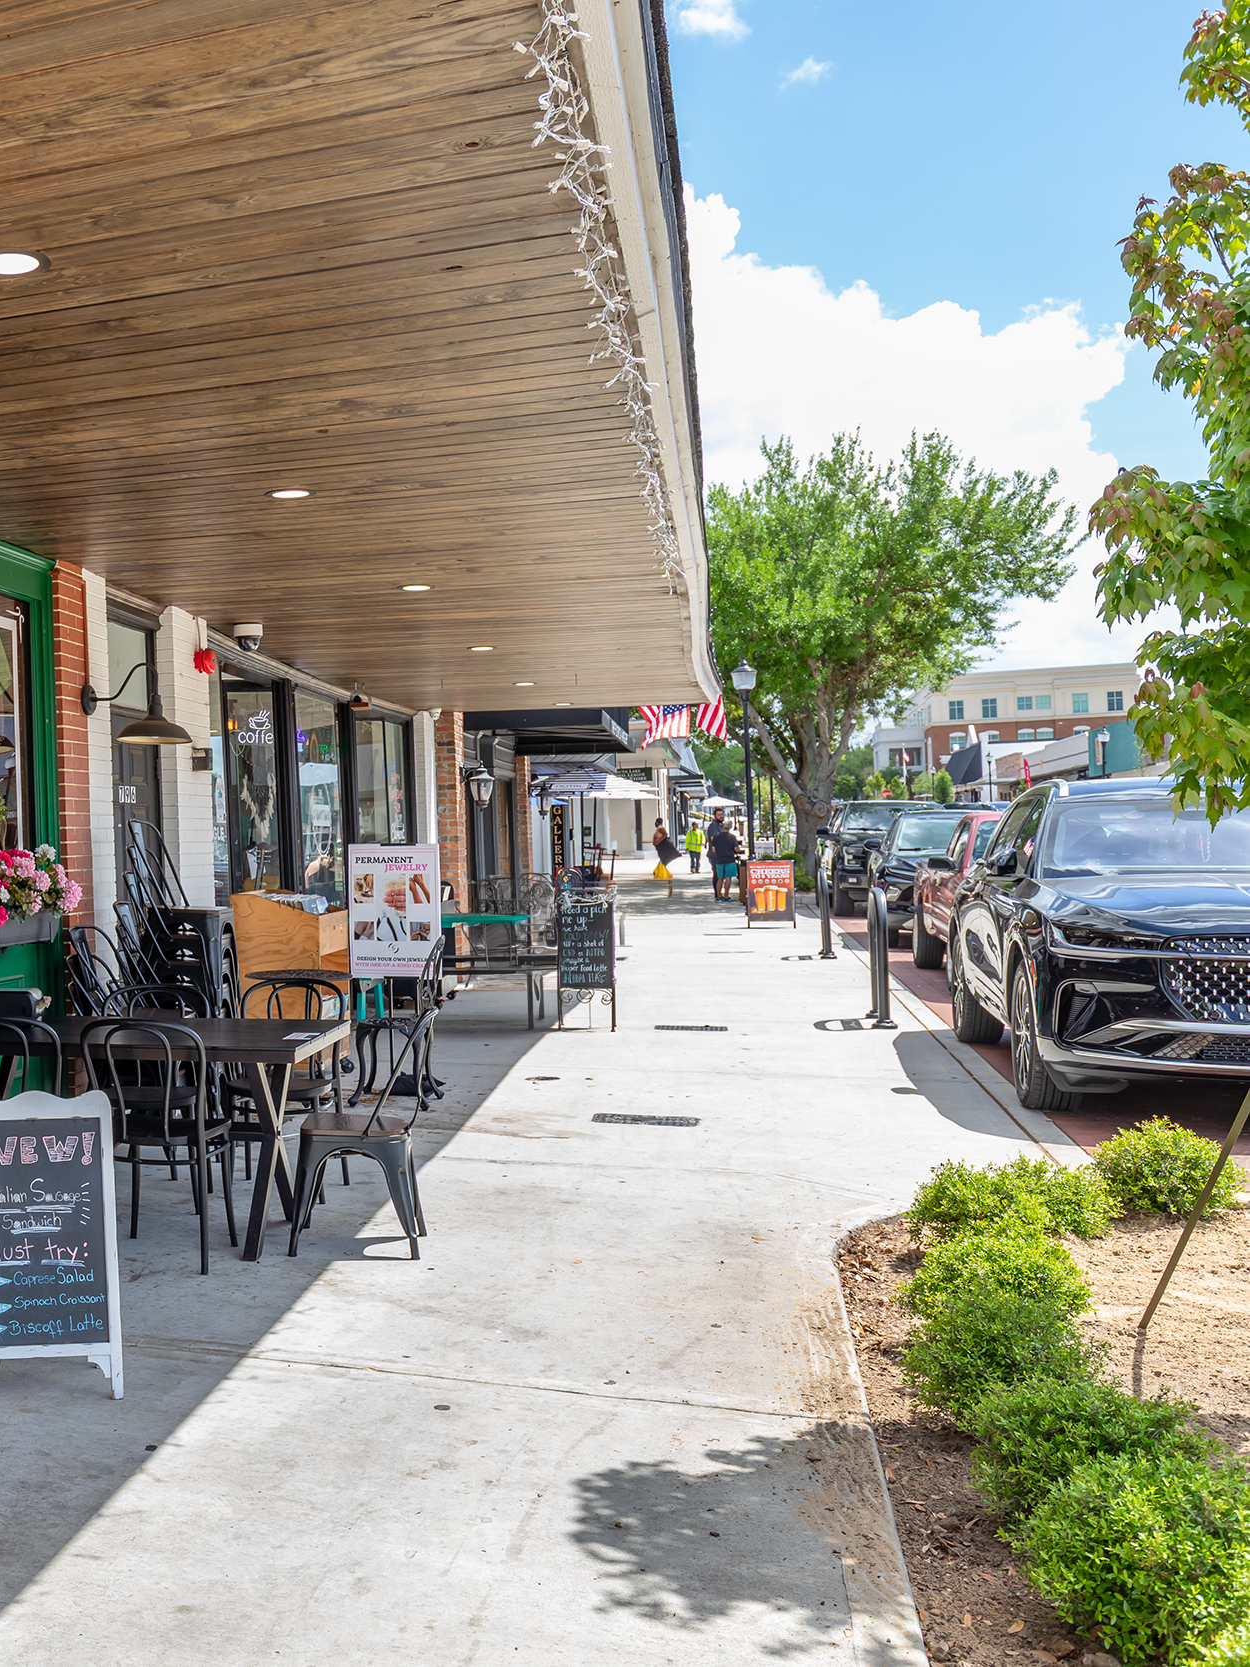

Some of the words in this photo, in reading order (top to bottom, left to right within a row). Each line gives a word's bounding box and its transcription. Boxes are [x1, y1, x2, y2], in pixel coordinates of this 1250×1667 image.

[237, 729, 274, 744] coffe
[553, 806, 563, 868] GALLER
[354, 856, 414, 864] PERMANENT
[384, 863, 428, 873] JEWELRY
[30, 1177, 82, 1205] Sausage
[1, 1211, 62, 1231] Sandwich
[44, 1238, 89, 1264] try:
[13, 1271, 56, 1288] Caprese
[56, 1266, 95, 1285] Salad
[59, 1293, 106, 1306] Croissant
[9, 1319, 64, 1339] Biscoff
[69, 1313, 104, 1332] Latte
